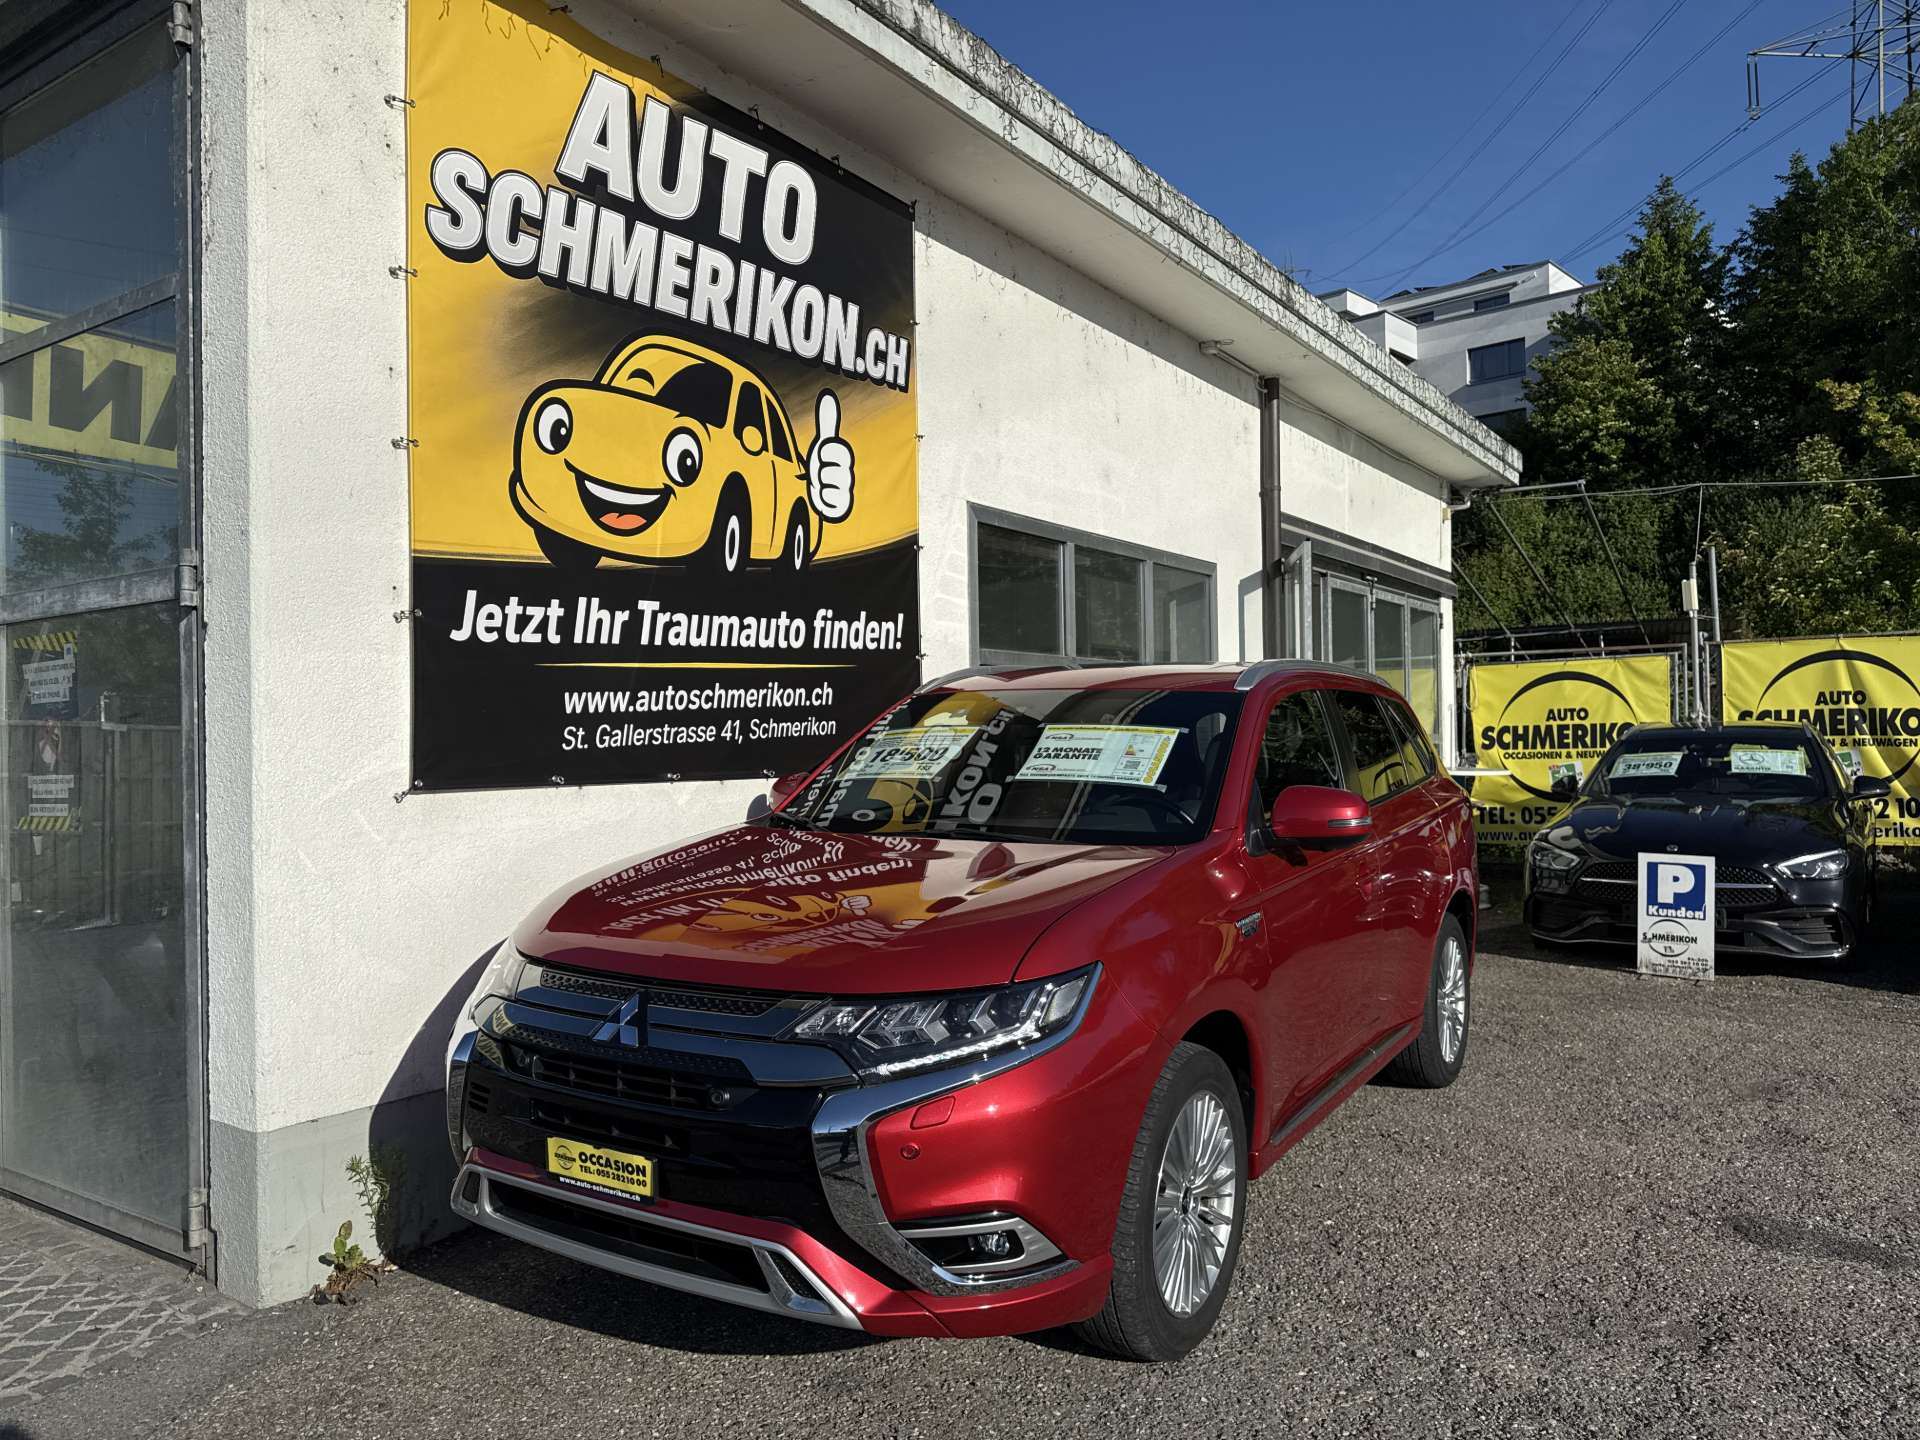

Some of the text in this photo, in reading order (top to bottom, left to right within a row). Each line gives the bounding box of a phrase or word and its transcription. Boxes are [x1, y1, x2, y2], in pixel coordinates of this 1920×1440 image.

[555, 70, 818, 265] AUTO
[426, 150, 910, 389] SCHMERIKON.CH
[449, 589, 904, 650] Jetzt Ihr Traumauto finden!
[564, 682, 834, 715] www.autoschmerikon.ch
[1815, 690, 1867, 706] AUTO
[1546, 708, 1589, 722] AUTO
[562, 717, 837, 750] St. Gallerstrasse 41, Schmerikon
[1051, 746, 1104, 754] MONATE
[1840, 738, 1849, 747] &
[1852, 738, 1918, 748] NEUWAGEN
[1033, 753, 1102, 761] GARANTIE
[1503, 750, 1606, 760] OCCASIONEN & NEUW
[1623, 761, 1673, 771] 38'950
[1477, 807, 1515, 824] TEL:
[1657, 863, 1696, 904] P
[1648, 905, 1705, 919] Kunden
[1642, 931, 1698, 945] SHMERIKON
[578, 1151, 647, 1177] OCCASION
[579, 1164, 596, 1175] TEL:
[560, 1176, 641, 1202] www.auto-schmerikon.ch
